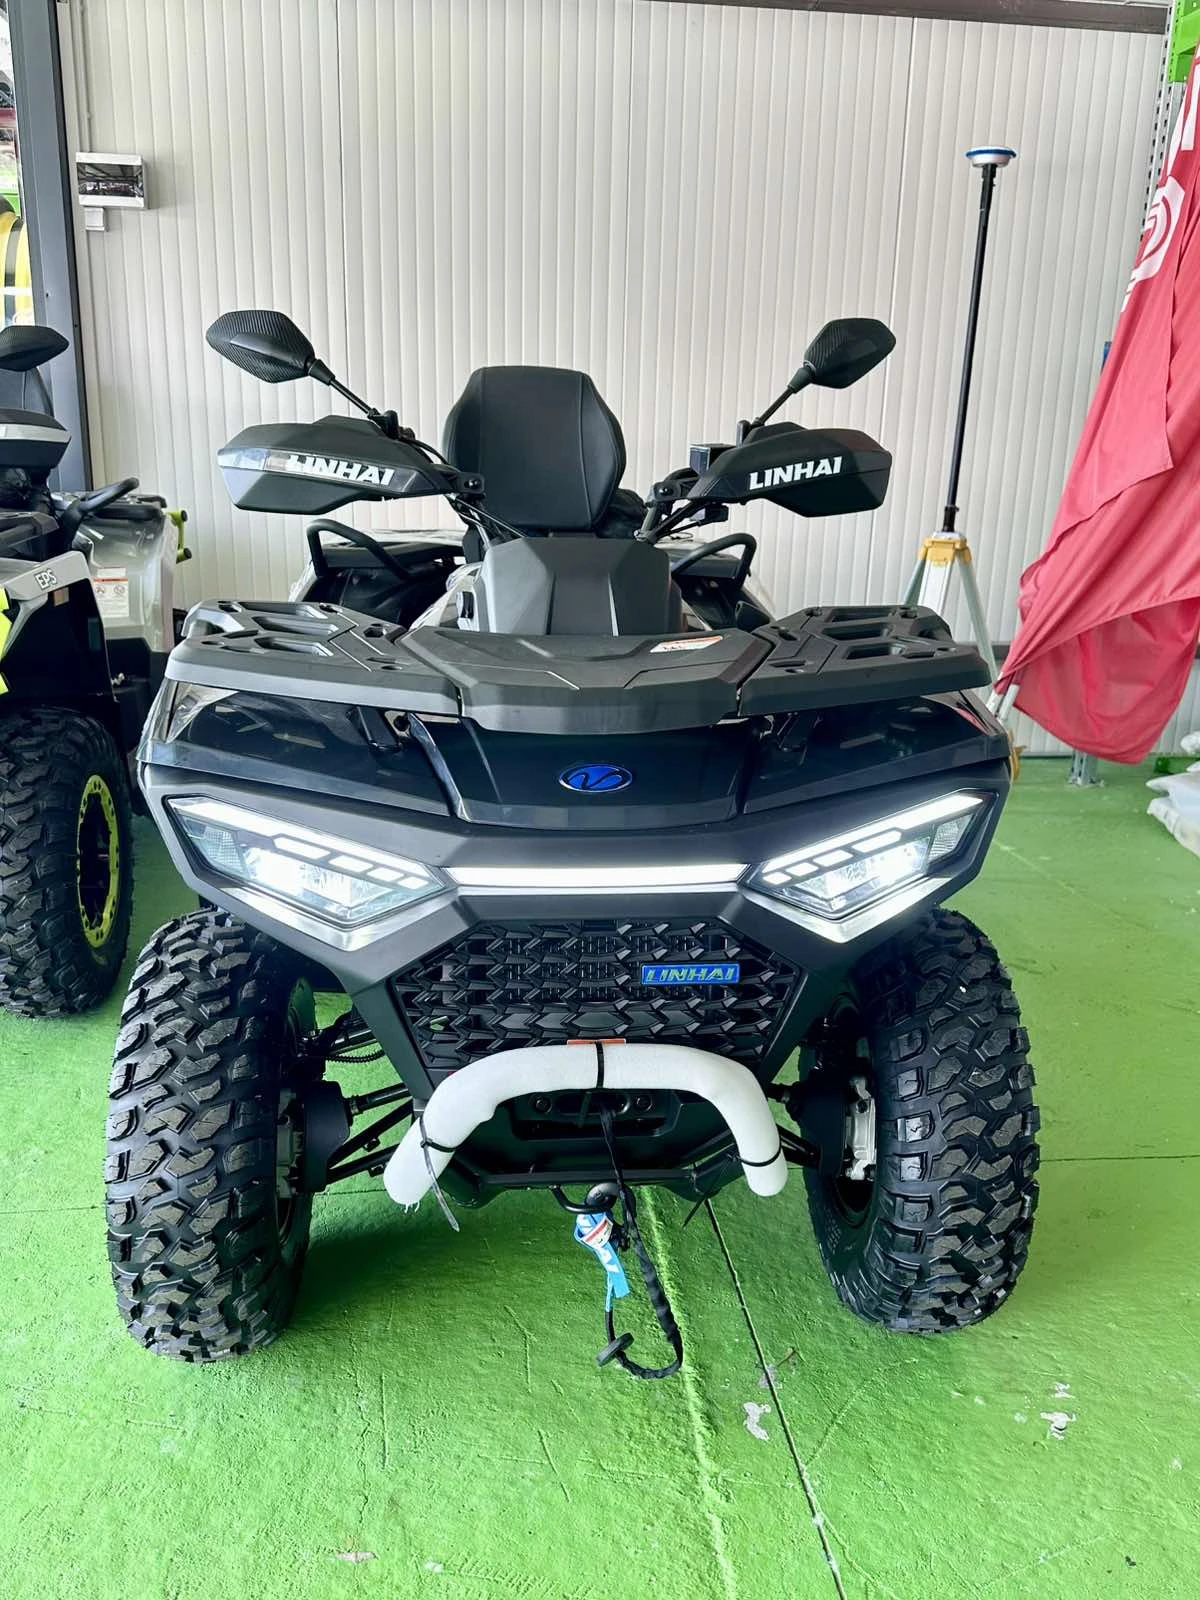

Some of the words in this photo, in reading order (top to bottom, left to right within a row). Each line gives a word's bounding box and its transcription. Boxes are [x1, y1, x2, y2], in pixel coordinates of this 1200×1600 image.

[285, 454, 395, 486] LINHAI
[749, 456, 843, 490] LINHAI
[34, 568, 57, 590] EPS
[645, 967, 735, 981] LINHAI
